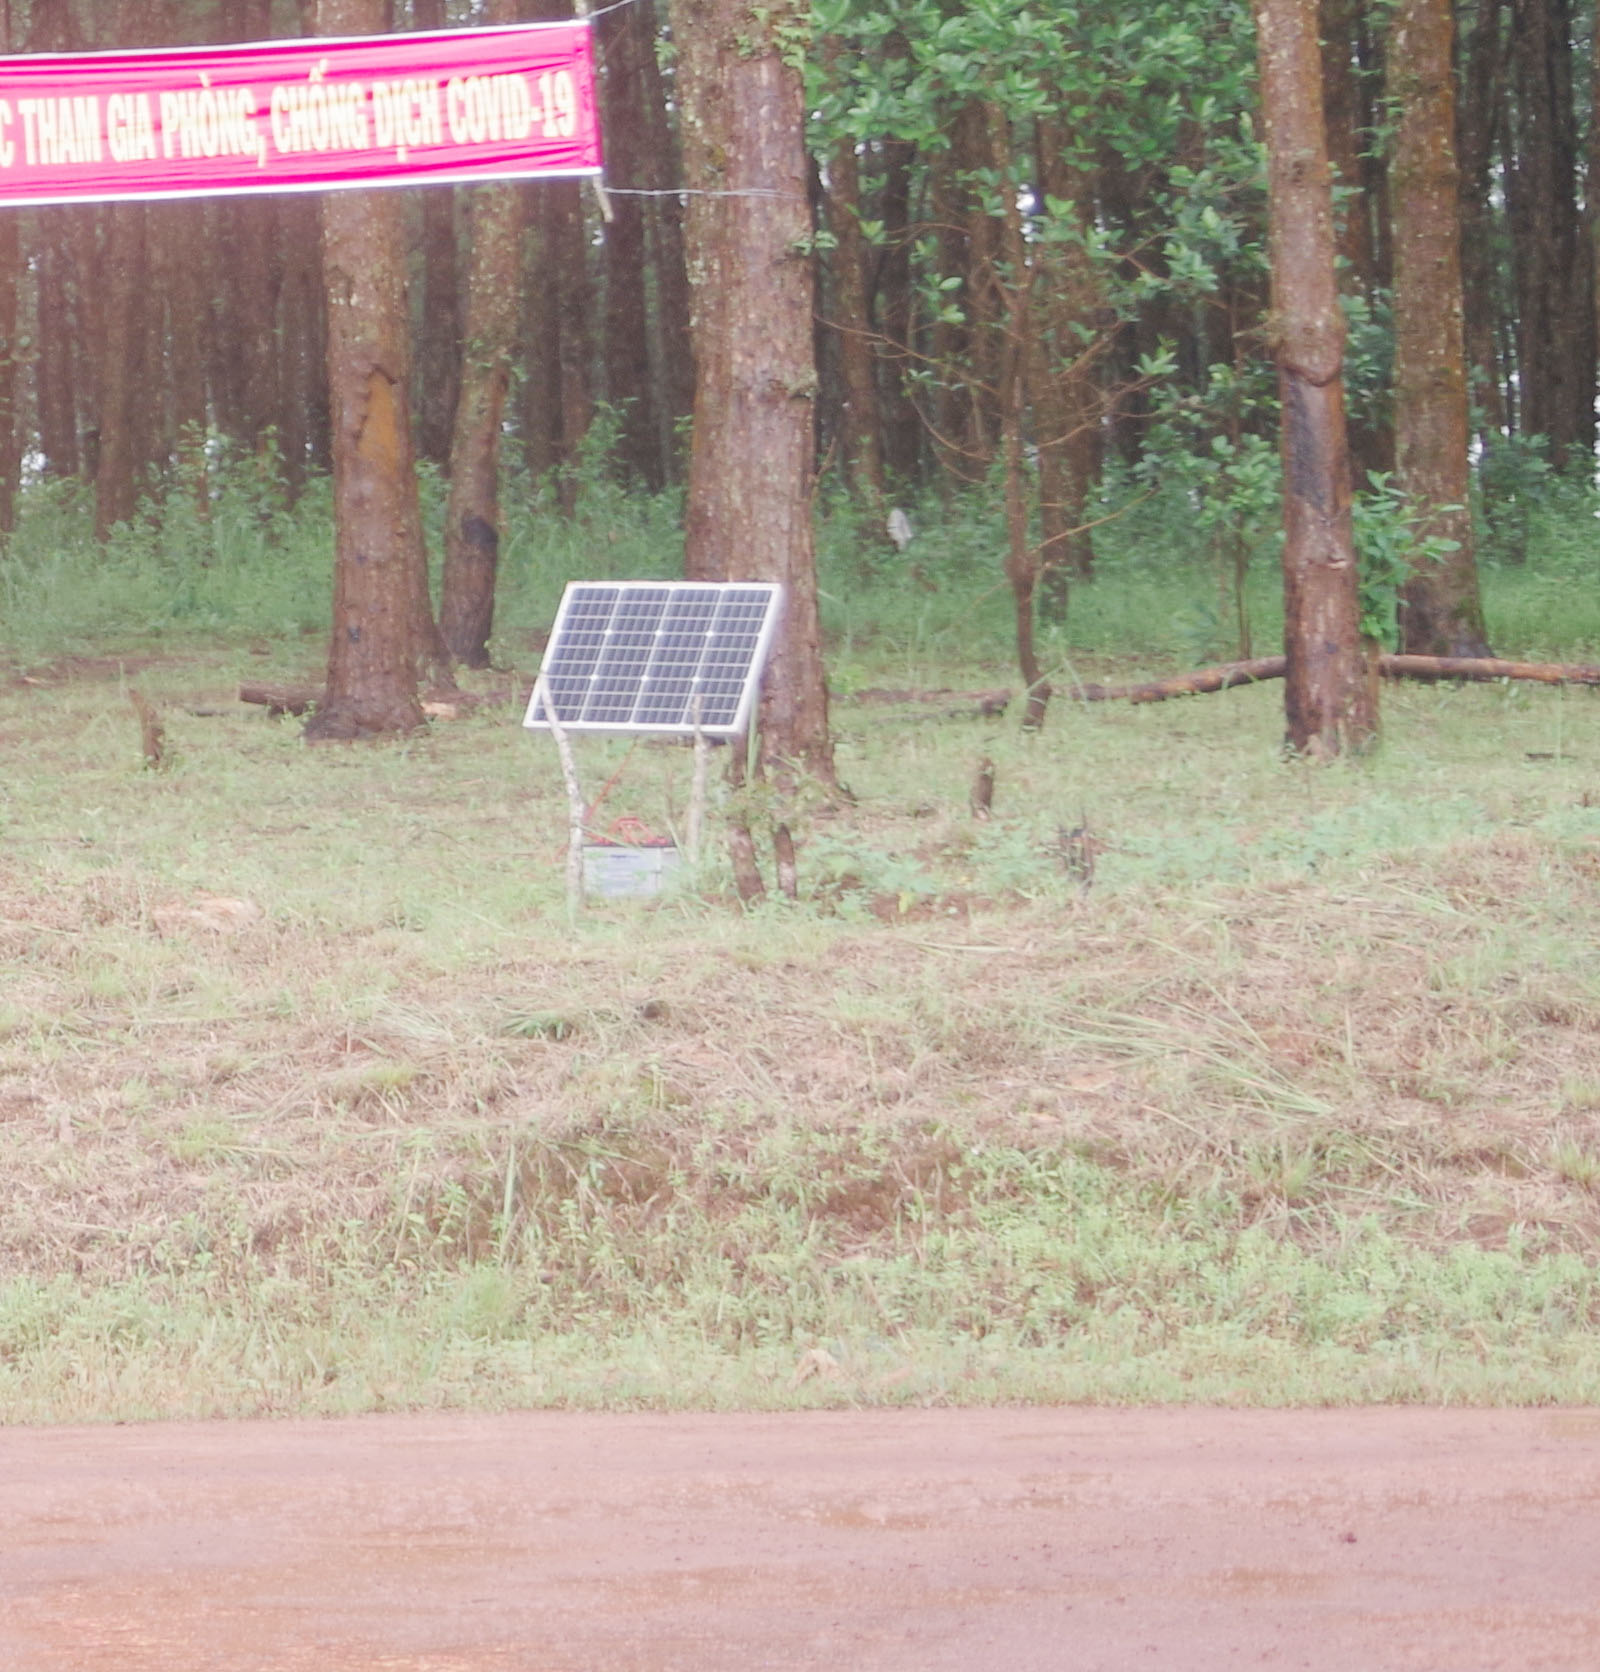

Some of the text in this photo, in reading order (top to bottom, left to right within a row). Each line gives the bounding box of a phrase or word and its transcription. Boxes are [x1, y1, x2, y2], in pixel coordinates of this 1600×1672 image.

[17, 95, 102, 165] THAM
[106, 94, 156, 162] GIA
[159, 72, 266, 168] PHÒNG,
[270, 59, 369, 154] CHỐNG
[372, 79, 443, 163] DỊCH
[447, 70, 576, 145] COVID-19
